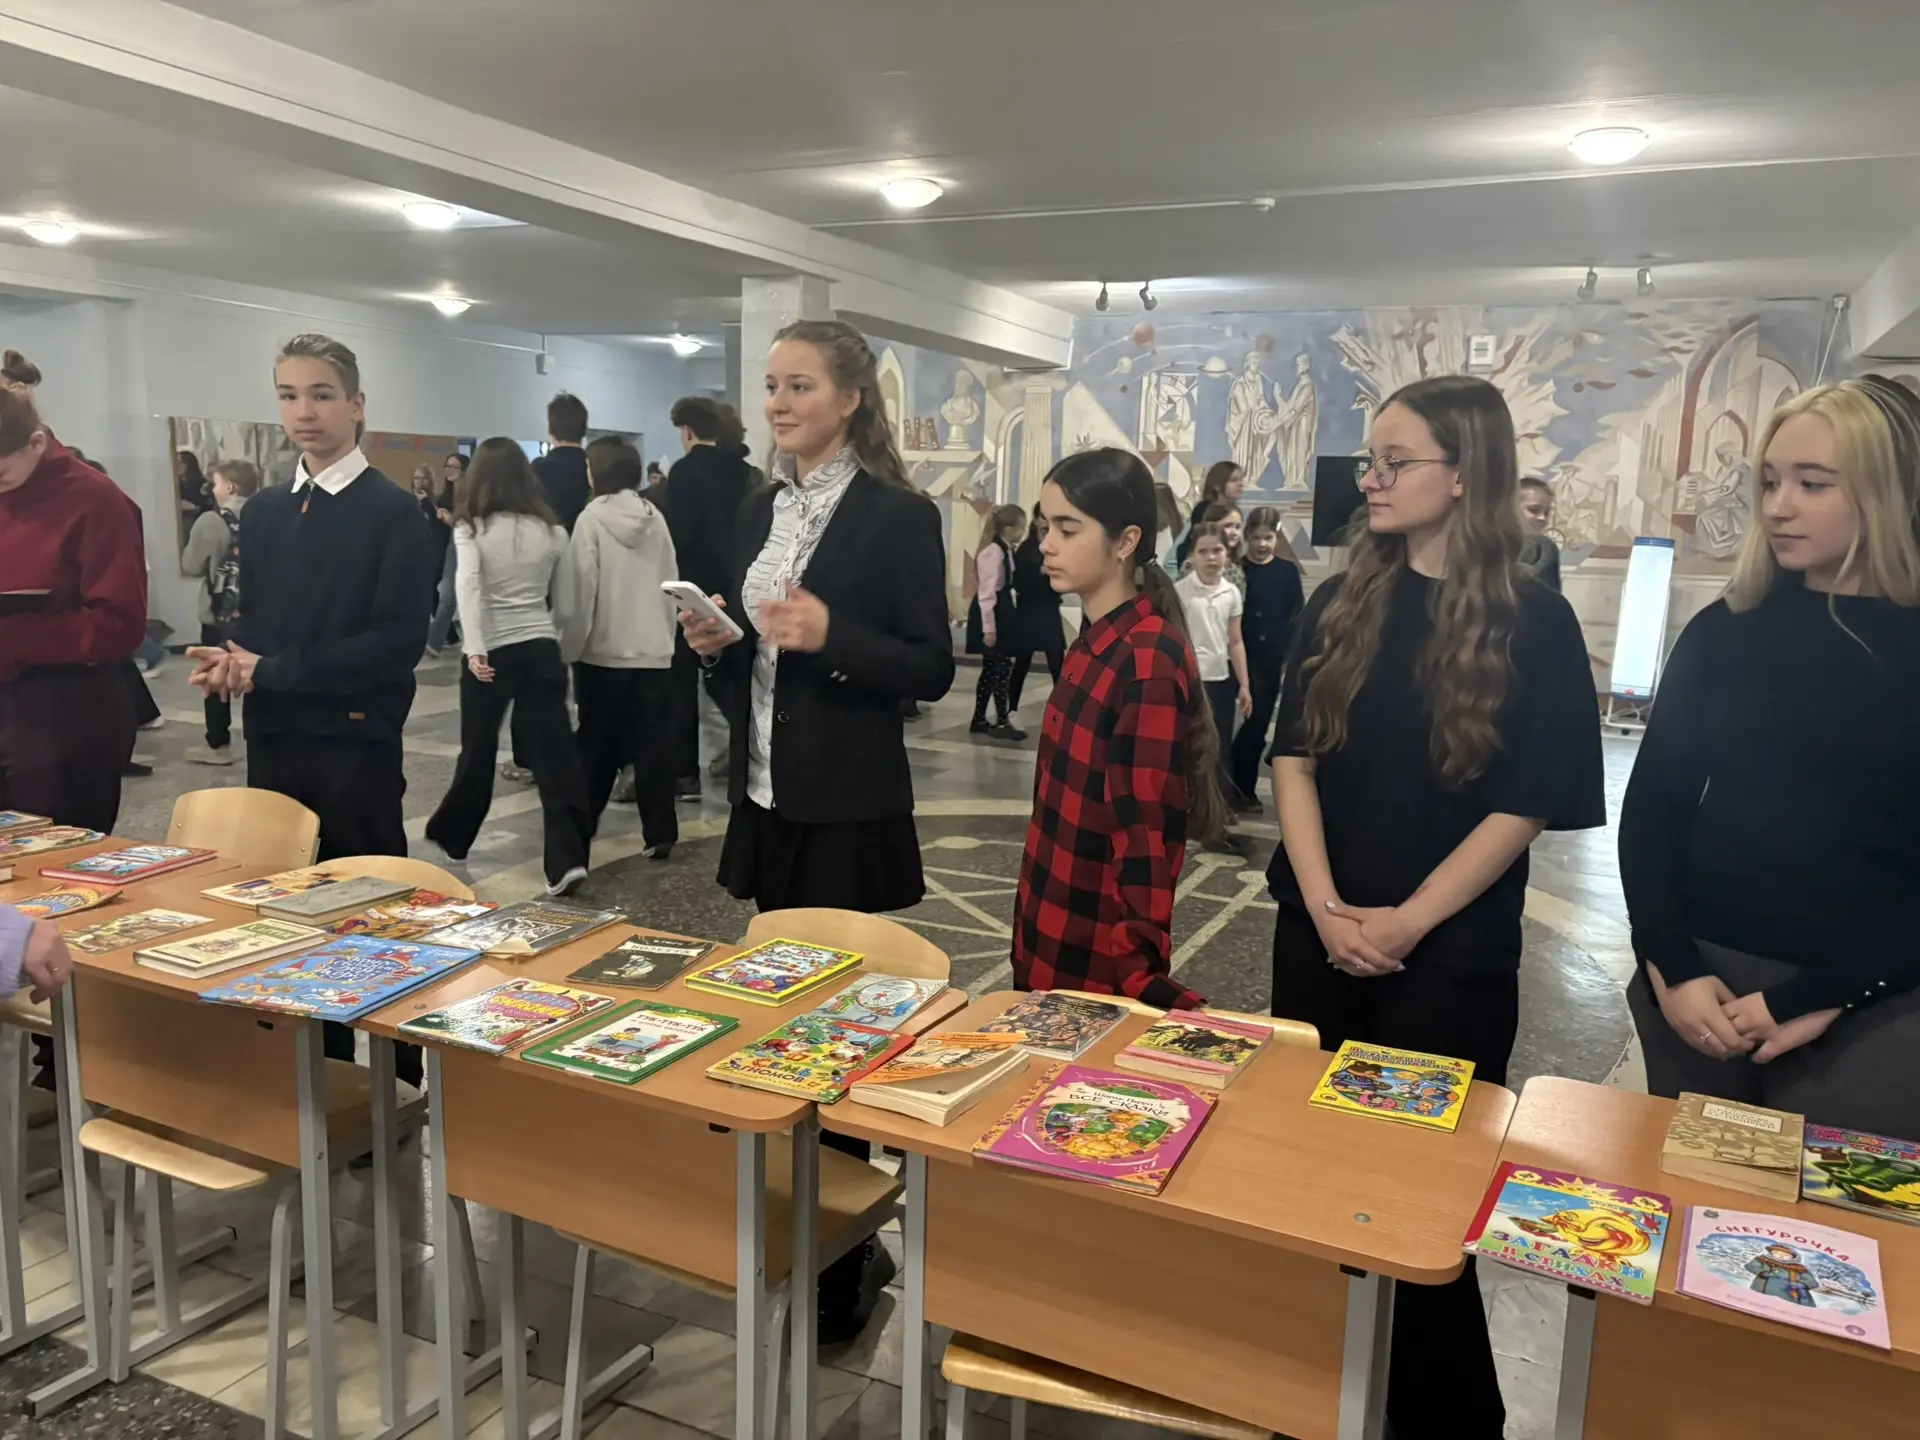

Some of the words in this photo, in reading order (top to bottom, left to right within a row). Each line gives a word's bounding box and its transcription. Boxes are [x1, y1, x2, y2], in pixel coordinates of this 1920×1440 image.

[740, 1065, 804, 1082] ГНОМОВ
[751, 1058, 811, 1078] СЕМЬ
[1069, 1093, 1103, 1103] ВСЕ
[1109, 1099, 1171, 1117] СКАЗКИ
[1126, 1097, 1155, 1108] Перро
[1491, 1230, 1645, 1281] ЗАГАДКИ
[1714, 1224, 1851, 1263] СНЕГУРОЧКА
[1523, 1252, 1624, 1287] СТИХАХ
